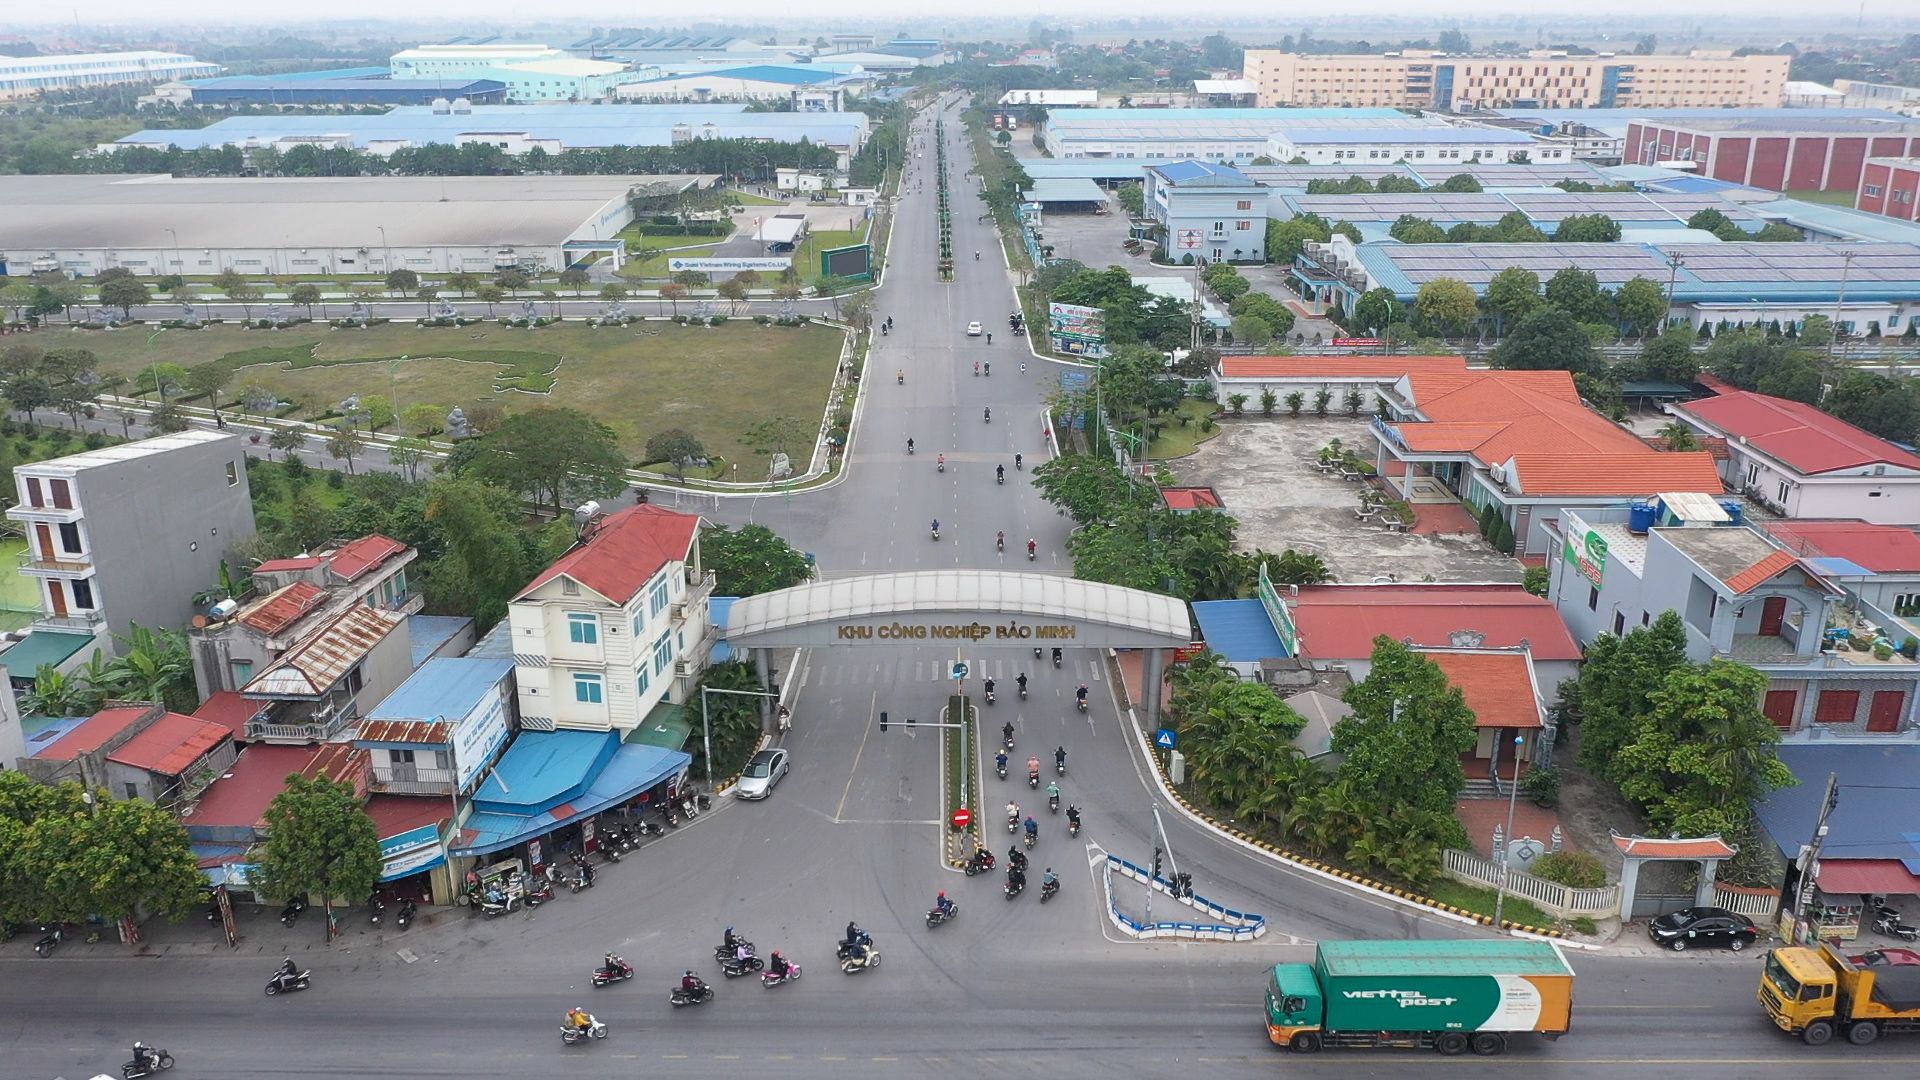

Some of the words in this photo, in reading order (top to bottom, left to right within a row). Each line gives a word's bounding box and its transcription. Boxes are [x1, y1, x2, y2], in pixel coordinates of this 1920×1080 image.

[742, 261, 767, 269] Systems
[838, 625, 873, 639] KHU
[877, 621, 927, 639] CÔNG
[930, 621, 991, 643] NGHIỆP
[995, 620, 1032, 639] BẢO
[1035, 625, 1077, 639] MINH
